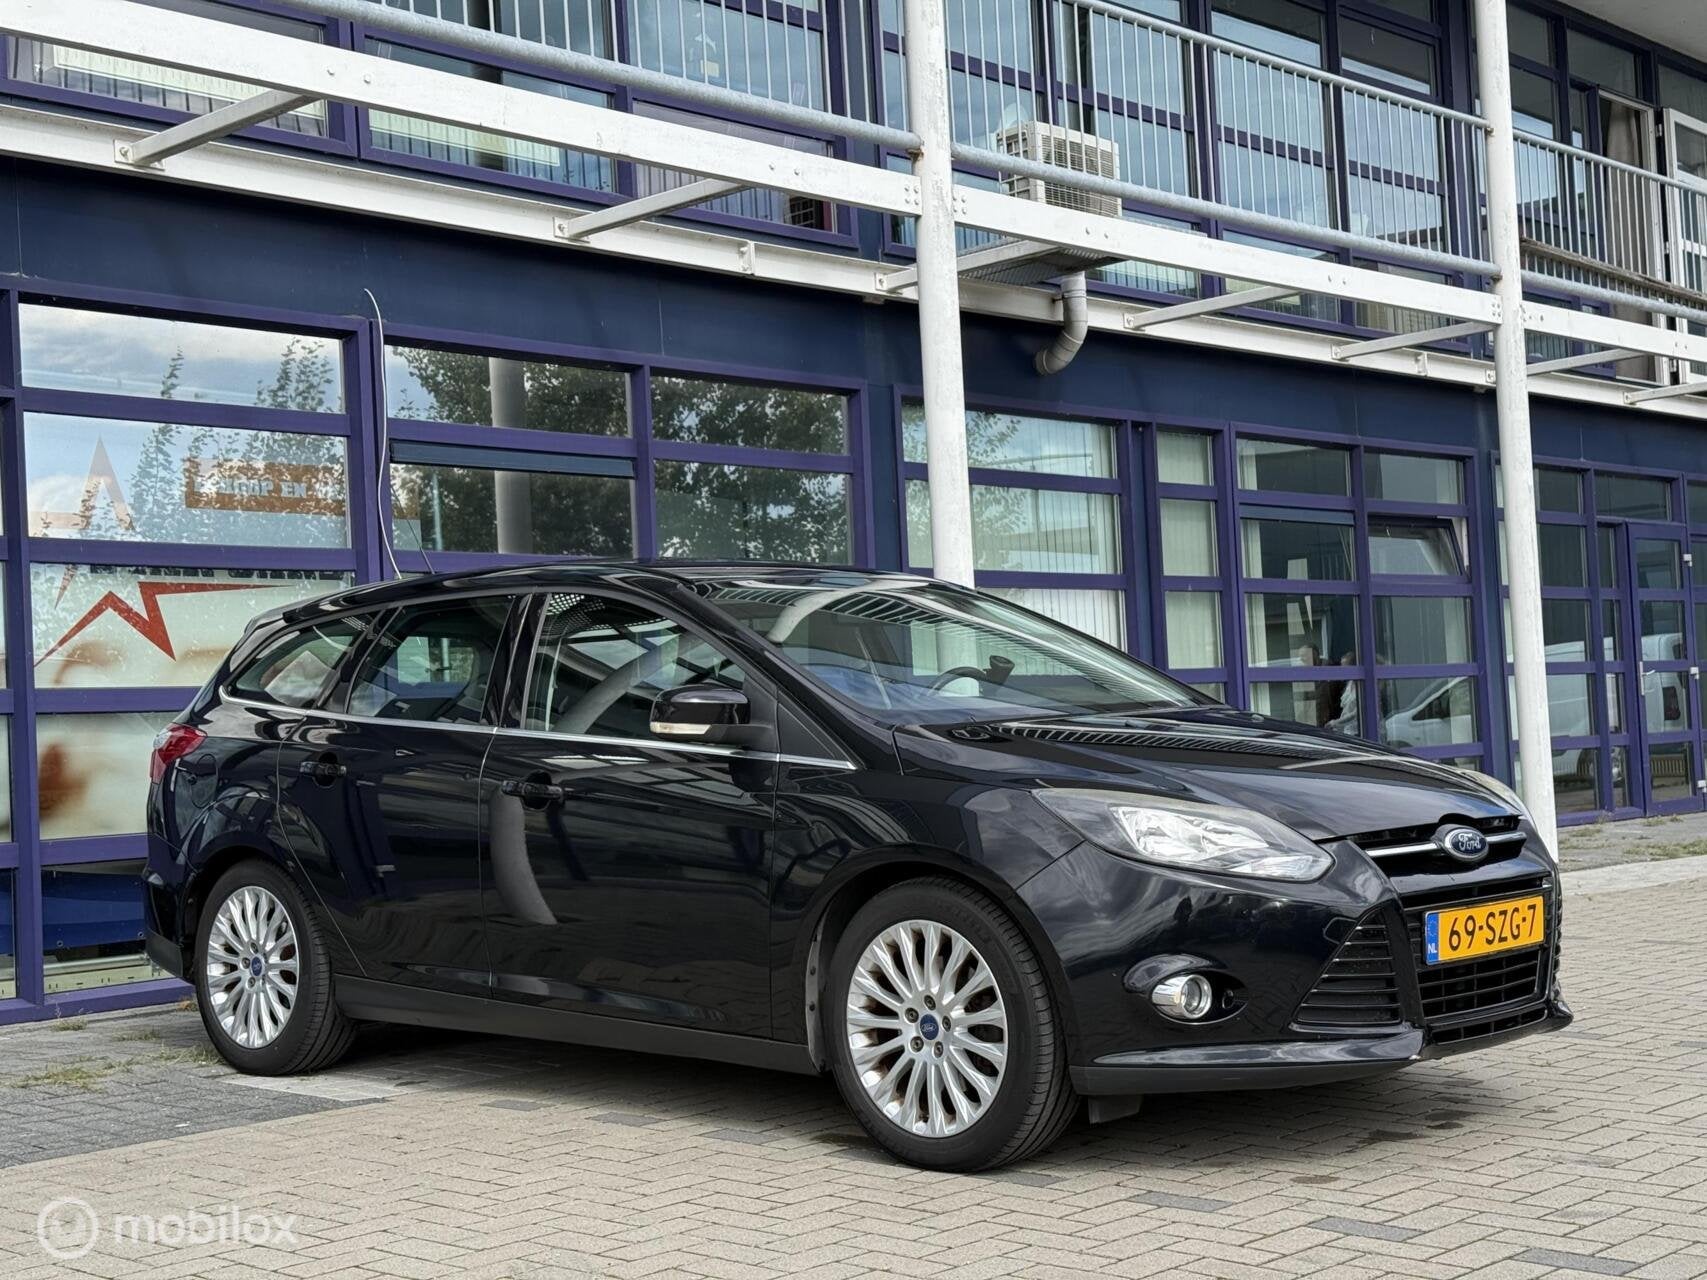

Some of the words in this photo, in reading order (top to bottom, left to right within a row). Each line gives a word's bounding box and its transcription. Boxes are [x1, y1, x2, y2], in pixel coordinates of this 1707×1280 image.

[1459, 832, 1482, 850] Ford
[1449, 904, 1537, 951] 69-SZG-7
[1427, 943, 1438, 953] NL
